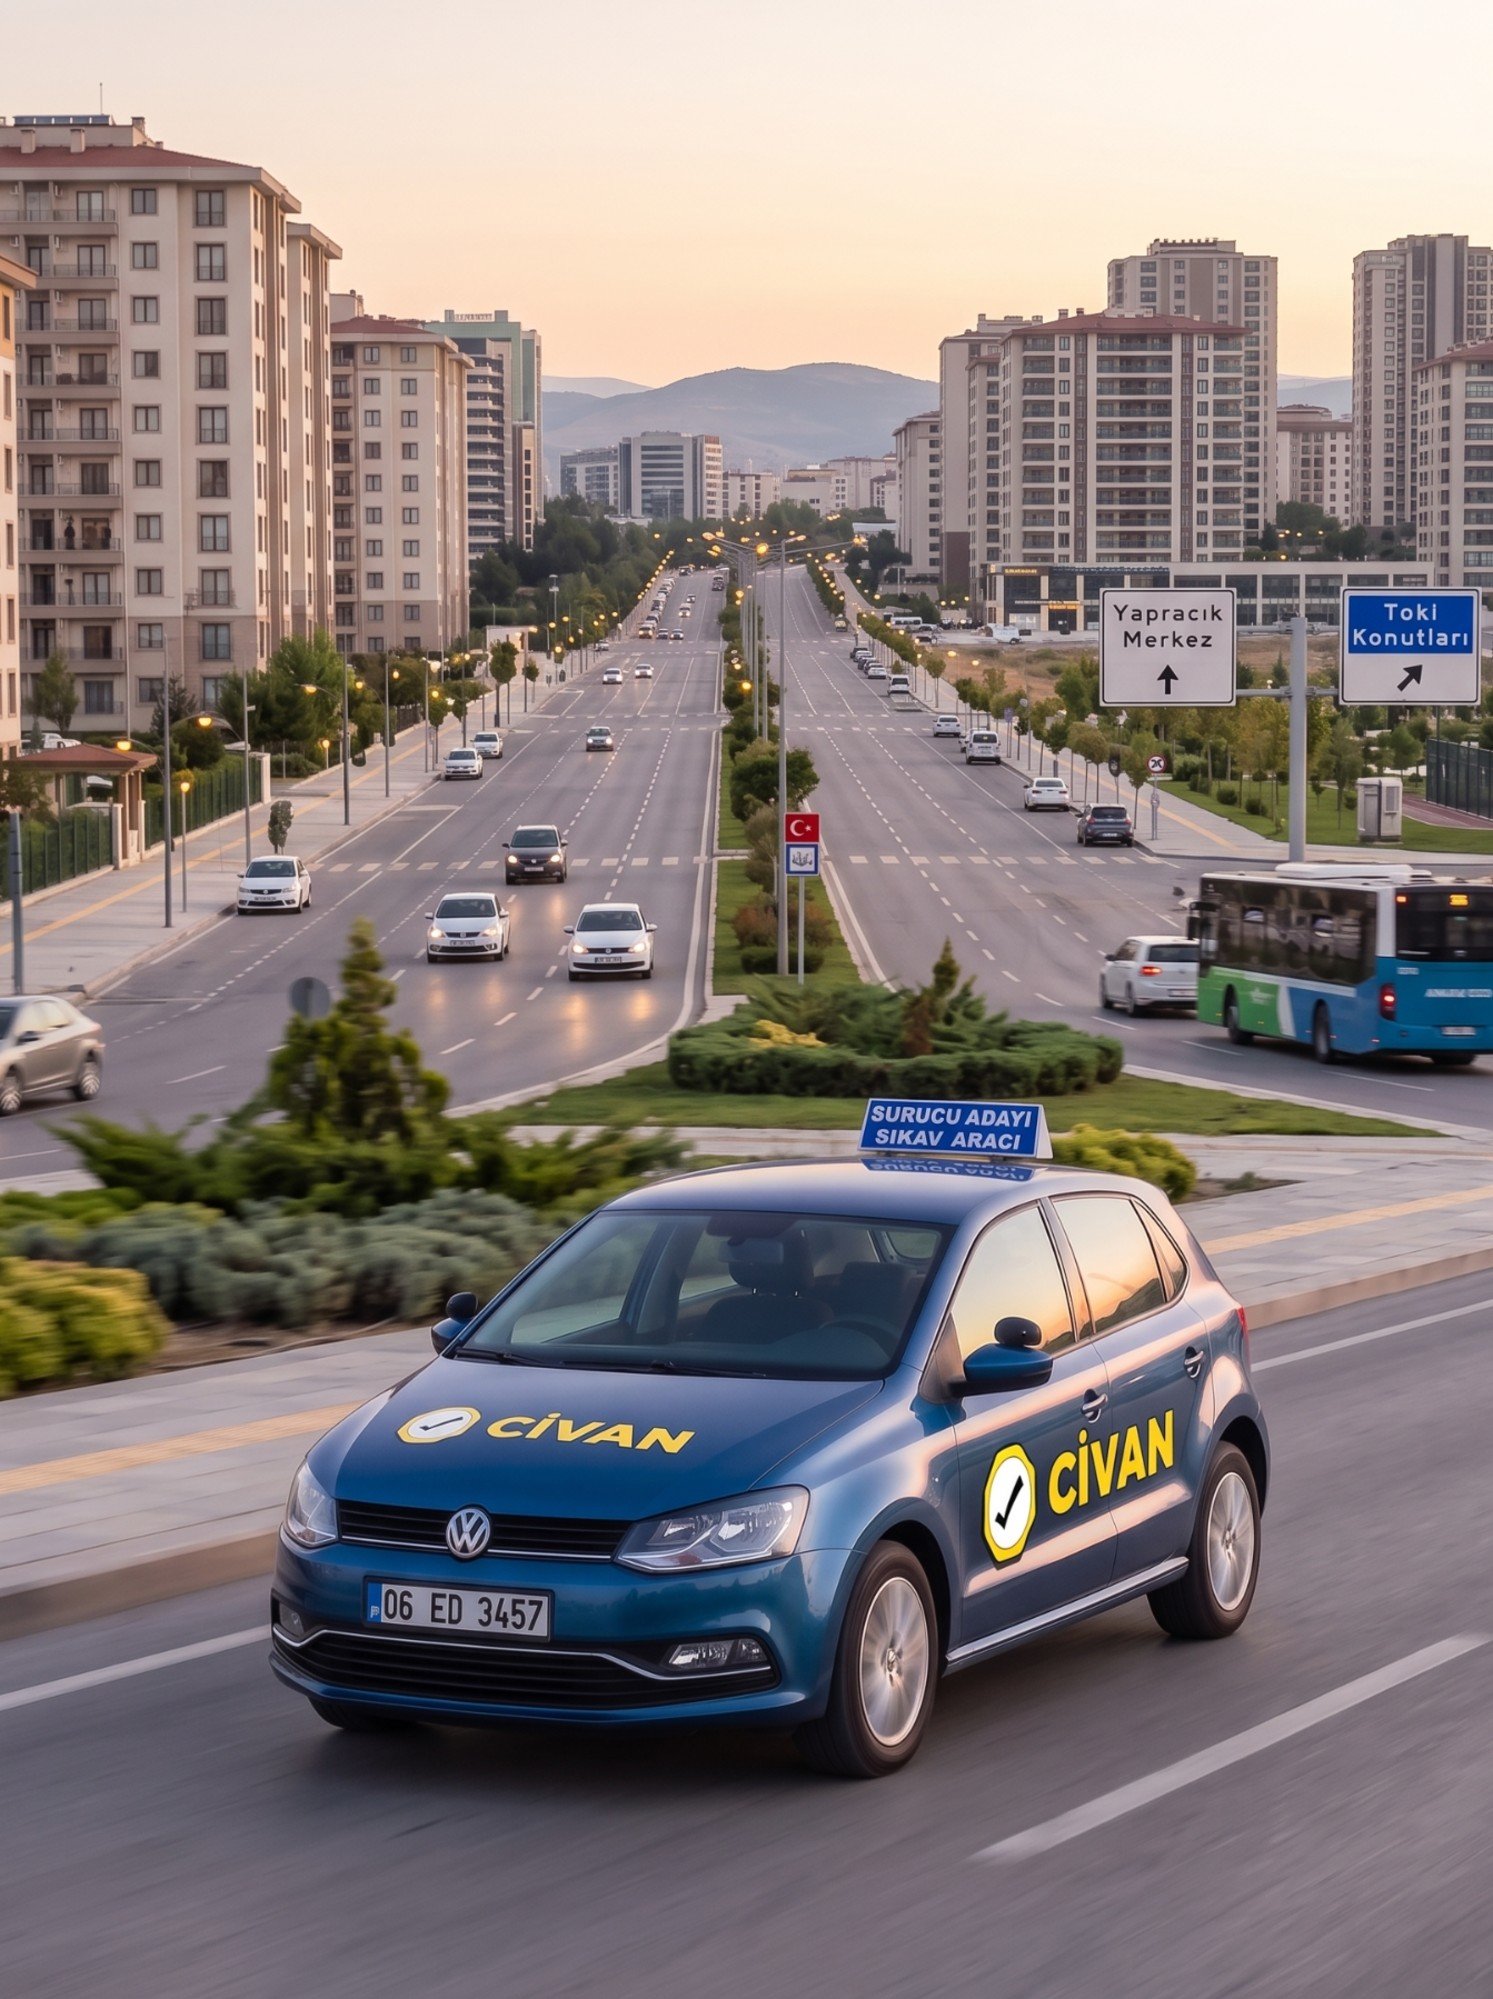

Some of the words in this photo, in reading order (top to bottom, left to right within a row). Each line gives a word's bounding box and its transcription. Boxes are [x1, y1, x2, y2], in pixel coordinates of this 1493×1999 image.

[1113, 604, 1223, 626] Yapracık
[1384, 603, 1437, 621] Toki
[1123, 630, 1212, 648] Merkez
[1353, 628, 1468, 646] Konutları
[870, 1105, 962, 1125] SURUCU
[964, 1110, 1032, 1128] ADAYI
[874, 1128, 944, 1146] SIKAV
[950, 1131, 1021, 1150] ARACI
[384, 1588, 413, 1621] 06
[430, 1592, 463, 1625] ED
[477, 1596, 543, 1631] 3457
